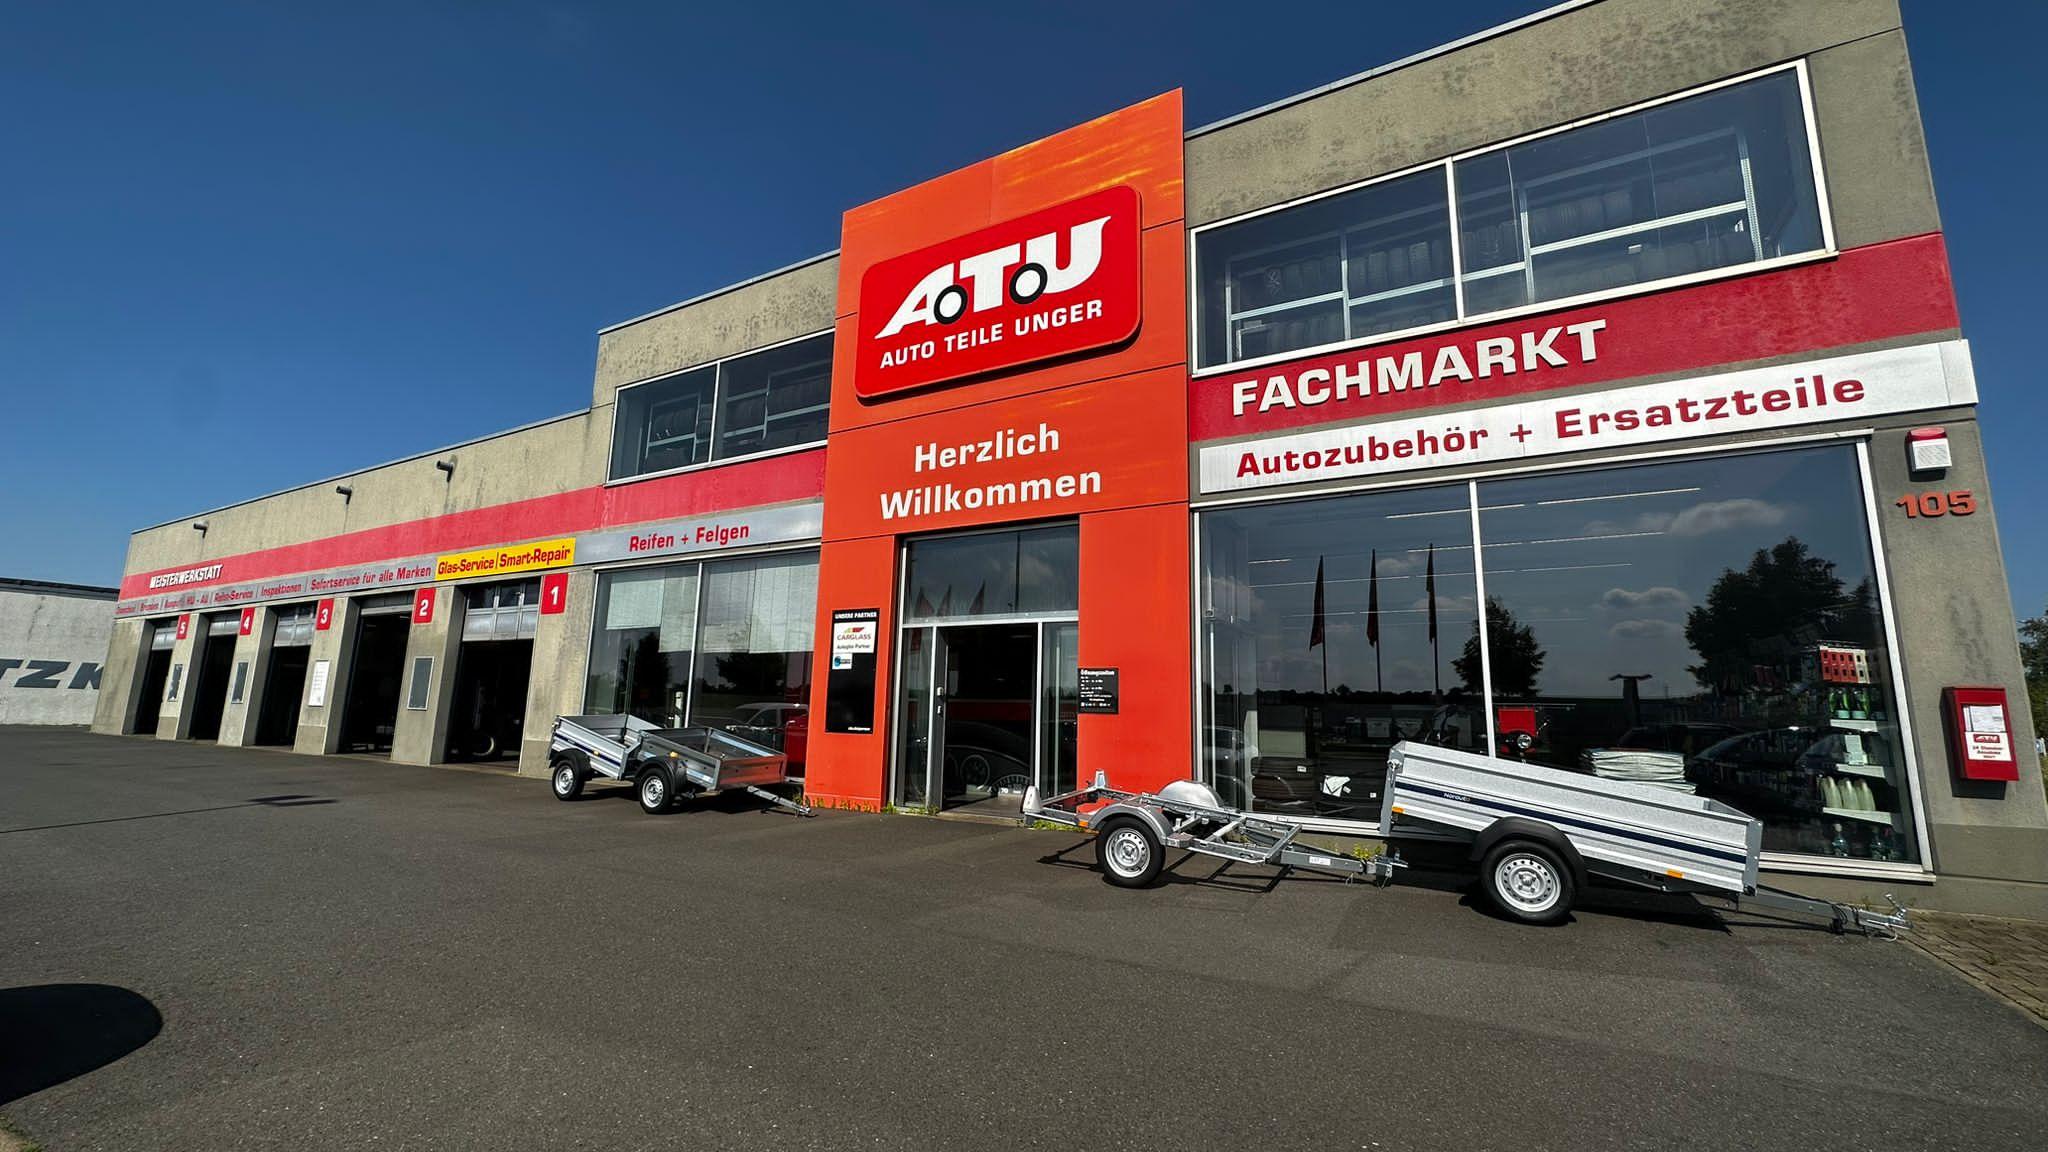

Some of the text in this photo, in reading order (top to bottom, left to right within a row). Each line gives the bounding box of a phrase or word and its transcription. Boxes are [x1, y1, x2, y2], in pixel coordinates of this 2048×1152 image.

[880, 299, 1103, 369] AUTO TEILE UNGER
[1233, 319, 1607, 416] FACHMARKT
[1237, 374, 1865, 478] Autozubehör + Ersatzteile
[914, 423, 1060, 472] Herzlich
[880, 471, 1101, 520] Willkommen
[1897, 489, 1978, 518] 105
[629, 524, 749, 552] Reifen + Felgen
[438, 545, 571, 575] Glas-Service Smart-Repair
[149, 564, 224, 589] MEISTERWERKSTATT
[311, 565, 432, 591] Sofortservice für alle Marken
[261, 583, 302, 598] Inspektionen
[550, 586, 559, 605] 1
[320, 608, 329, 624] 3
[419, 600, 429, 617] 2
[179, 622, 186, 635] 5
[243, 616, 250, 629] 4
